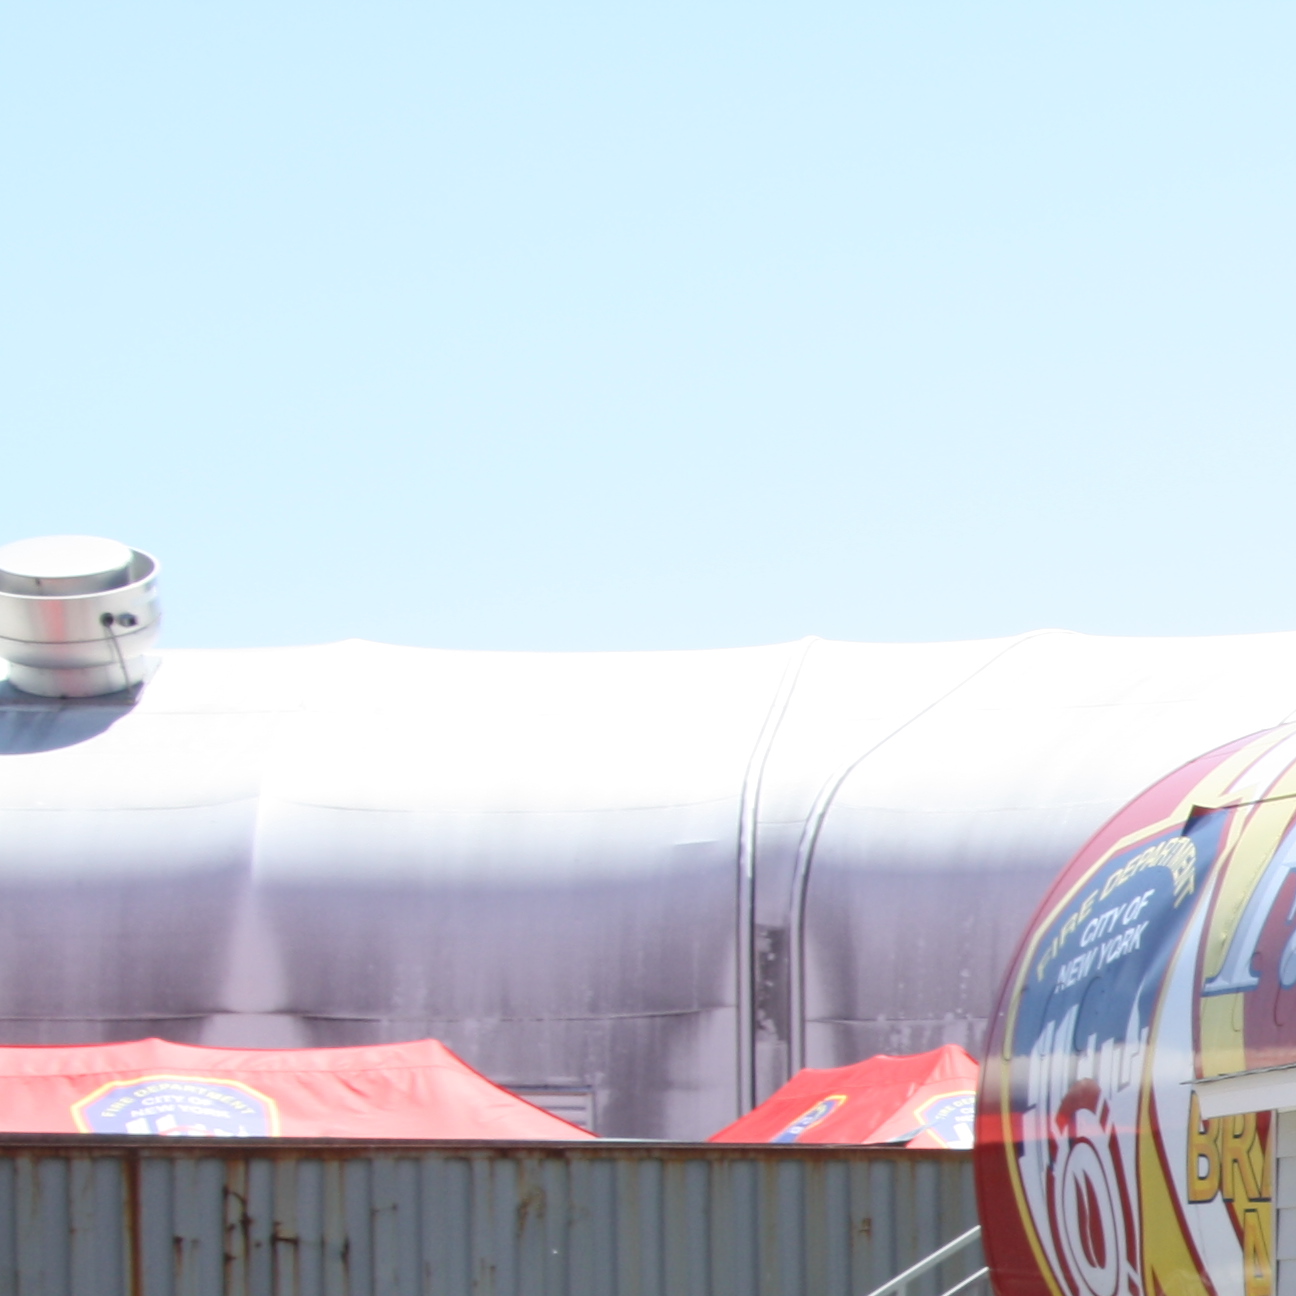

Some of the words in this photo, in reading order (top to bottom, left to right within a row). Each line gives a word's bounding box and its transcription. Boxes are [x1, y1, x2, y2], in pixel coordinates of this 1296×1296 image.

[1037, 889, 1099, 982] FIRE
[1080, 903, 1126, 947] CITY
[1122, 889, 1155, 925] OF
[1054, 947, 1099, 994] NEW
[1097, 921, 1149, 970] YORK
[131, 1104, 176, 1118] NEW
[176, 1104, 231, 1118] YORK
[133, 1083, 256, 1115] DEPARTMENT
[141, 1095, 185, 1106] CITY
[188, 1096, 213, 1106] OF
